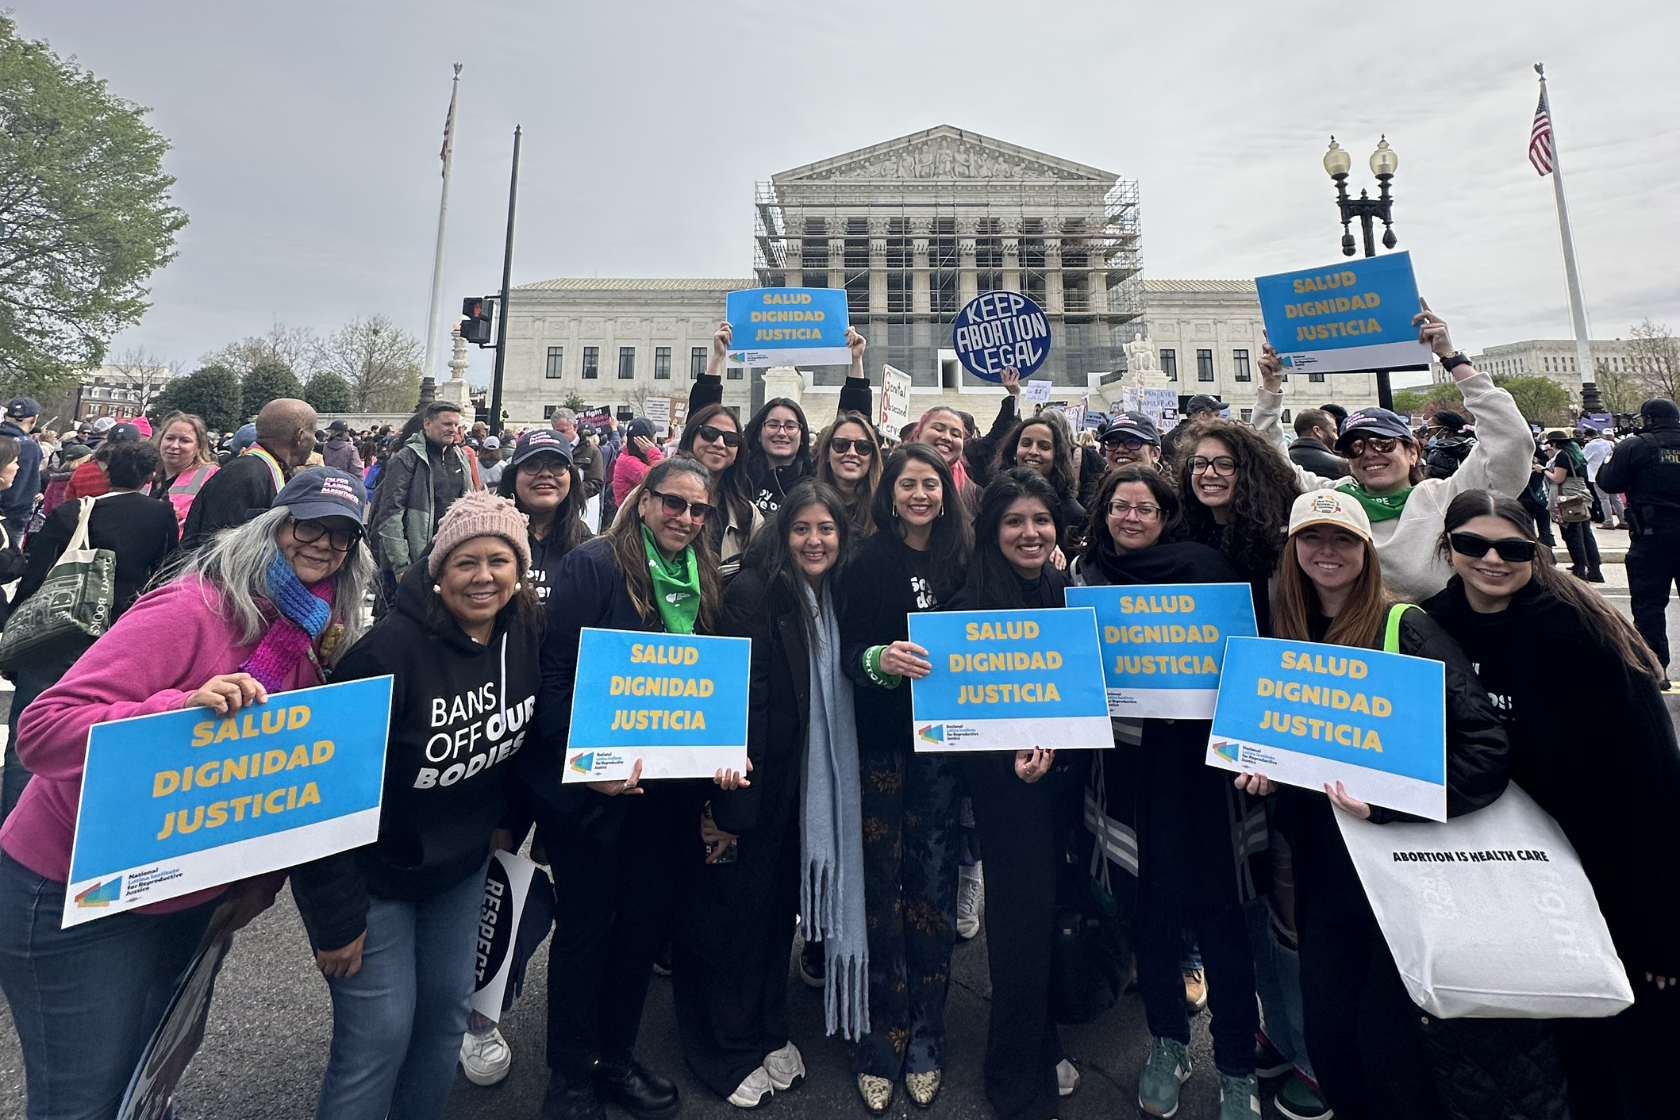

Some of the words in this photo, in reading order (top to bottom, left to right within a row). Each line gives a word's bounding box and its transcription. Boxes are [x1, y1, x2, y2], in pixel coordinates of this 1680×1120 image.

[1294, 271, 1356, 293] SALUD
[764, 294, 811, 304] SALUD
[966, 293, 1025, 324] KEEP
[1285, 293, 1380, 318] DIGNIDAD
[751, 311, 824, 322] DIGNIDAD
[756, 329, 821, 340] JUSTICIA
[957, 312, 1047, 353] ABORTION
[1298, 318, 1381, 340] JUSTICIA
[969, 340, 1042, 374] LEGAL
[586, 409, 603, 418] fight
[1661, 454, 1680, 464] POL
[760, 489, 773, 501] oy
[526, 569, 547, 582] oy
[1120, 596, 1195, 613] SALUD
[90, 597, 107, 636] BOOKS
[966, 621, 1039, 640] SALUD
[1105, 625, 1219, 643] DIGNIDAD
[631, 644, 698, 665] SALUD
[950, 651, 1062, 672] DIGNIDAD
[1116, 656, 1218, 674] JUSTICIA
[1281, 651, 1367, 678] SALUD
[610, 676, 714, 697] DIGNIDAD
[958, 683, 1060, 704] JUSTICIA
[430, 681, 497, 728] BANS
[1258, 679, 1392, 717] DIGNIDAD
[192, 705, 311, 747] SALUD
[425, 720, 482, 763] OFF
[486, 695, 536, 742] OUR
[612, 710, 705, 730] JUSTICIA
[1260, 711, 1382, 752] JUSTICIA
[153, 740, 335, 797] DIGNIDAD
[412, 730, 527, 789] BODIES
[158, 782, 320, 839] JUSTICIA
[1393, 851, 1455, 863] ABORTION
[1457, 851, 1469, 863] IS
[1469, 850, 1517, 863] HEALTH
[1517, 850, 1550, 863] CARE
[128, 867, 159, 880] National
[138, 872, 183, 887] Reproductive
[150, 868, 180, 880] Institute
[125, 886, 150, 896] Justice
[474, 877, 505, 982] RESPECT
